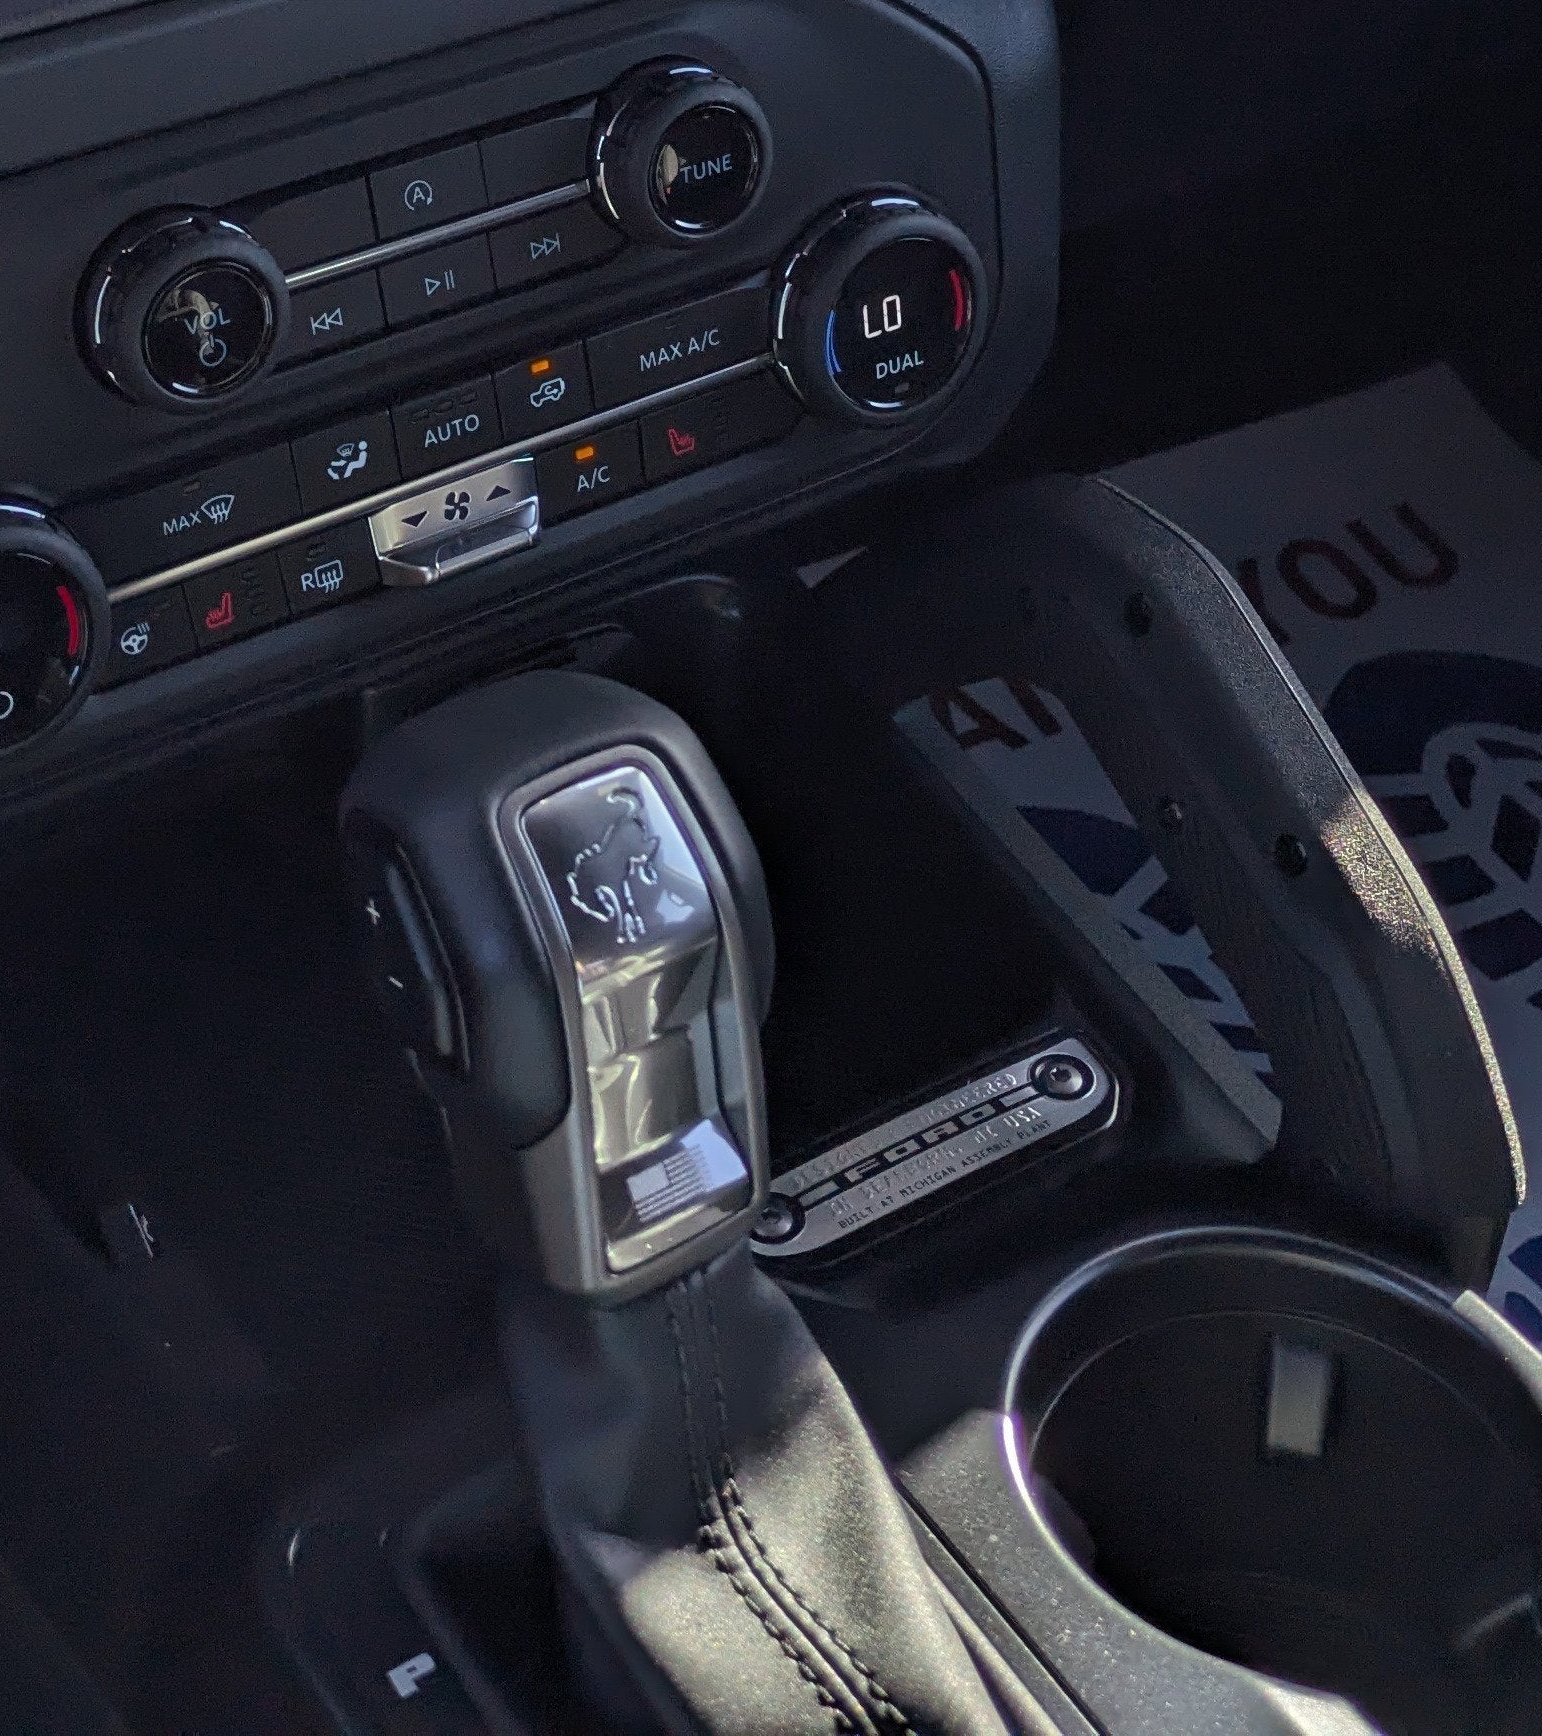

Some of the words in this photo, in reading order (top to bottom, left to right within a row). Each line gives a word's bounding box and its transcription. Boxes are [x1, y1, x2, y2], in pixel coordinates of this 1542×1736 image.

[680, 153, 732, 184] TUNE
[183, 307, 230, 336] VOL
[862, 294, 902, 339] LO
[639, 341, 680, 372] MAX
[687, 329, 720, 358] A/C
[875, 350, 925, 380] DUAL
[424, 414, 480, 448] AUTO
[577, 465, 611, 493] A/C
[162, 510, 201, 536] MAX
[844, 1103, 996, 1183] FORD
[837, 1205, 874, 1229] BUILT
[880, 1193, 895, 1208] AT
[899, 1165, 957, 1198] MICHIGAN
[960, 1137, 1013, 1169] ASSEMBLY
[1016, 1119, 1052, 1140] PLANT
[387, 1652, 436, 1698] P
